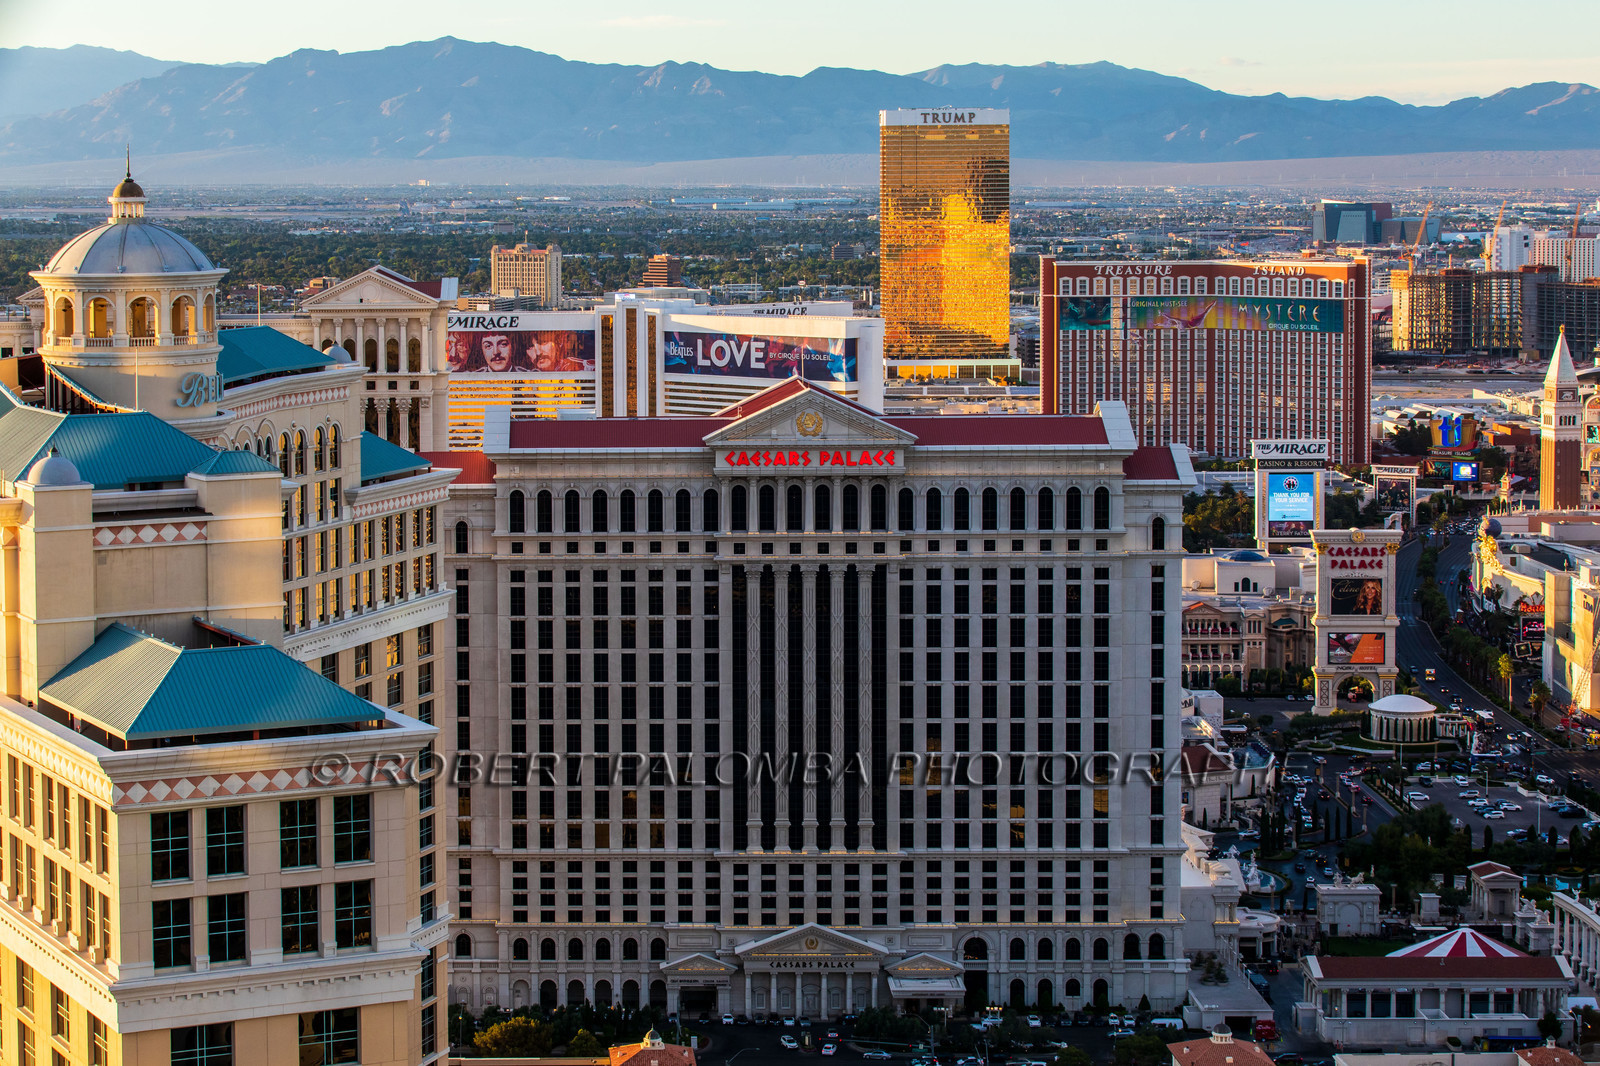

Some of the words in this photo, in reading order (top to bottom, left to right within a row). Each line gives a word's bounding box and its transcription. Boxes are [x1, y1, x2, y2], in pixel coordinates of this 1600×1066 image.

[920, 112, 976, 124] TRUMP
[1094, 265, 1173, 276] TREASURE
[1253, 265, 1305, 276] ISLAND
[1131, 300, 1159, 308] ORIGINAL
[448, 316, 519, 330] MIRAGE
[1268, 323, 1290, 331] CIRQUE
[669, 341, 694, 358] BEATLES
[696, 338, 766, 369] LOVE
[777, 352, 800, 362] CIRQUE
[811, 353, 832, 362] SOLEIL
[1262, 443, 1326, 455] MIRAGE
[724, 450, 812, 467] CAESARS
[819, 450, 896, 467] PALACE
[1327, 546, 1387, 558] CAESARS
[1330, 559, 1384, 570] PALACE
[769, 961, 813, 969] CAESARS
[817, 961, 855, 969] PALACE
